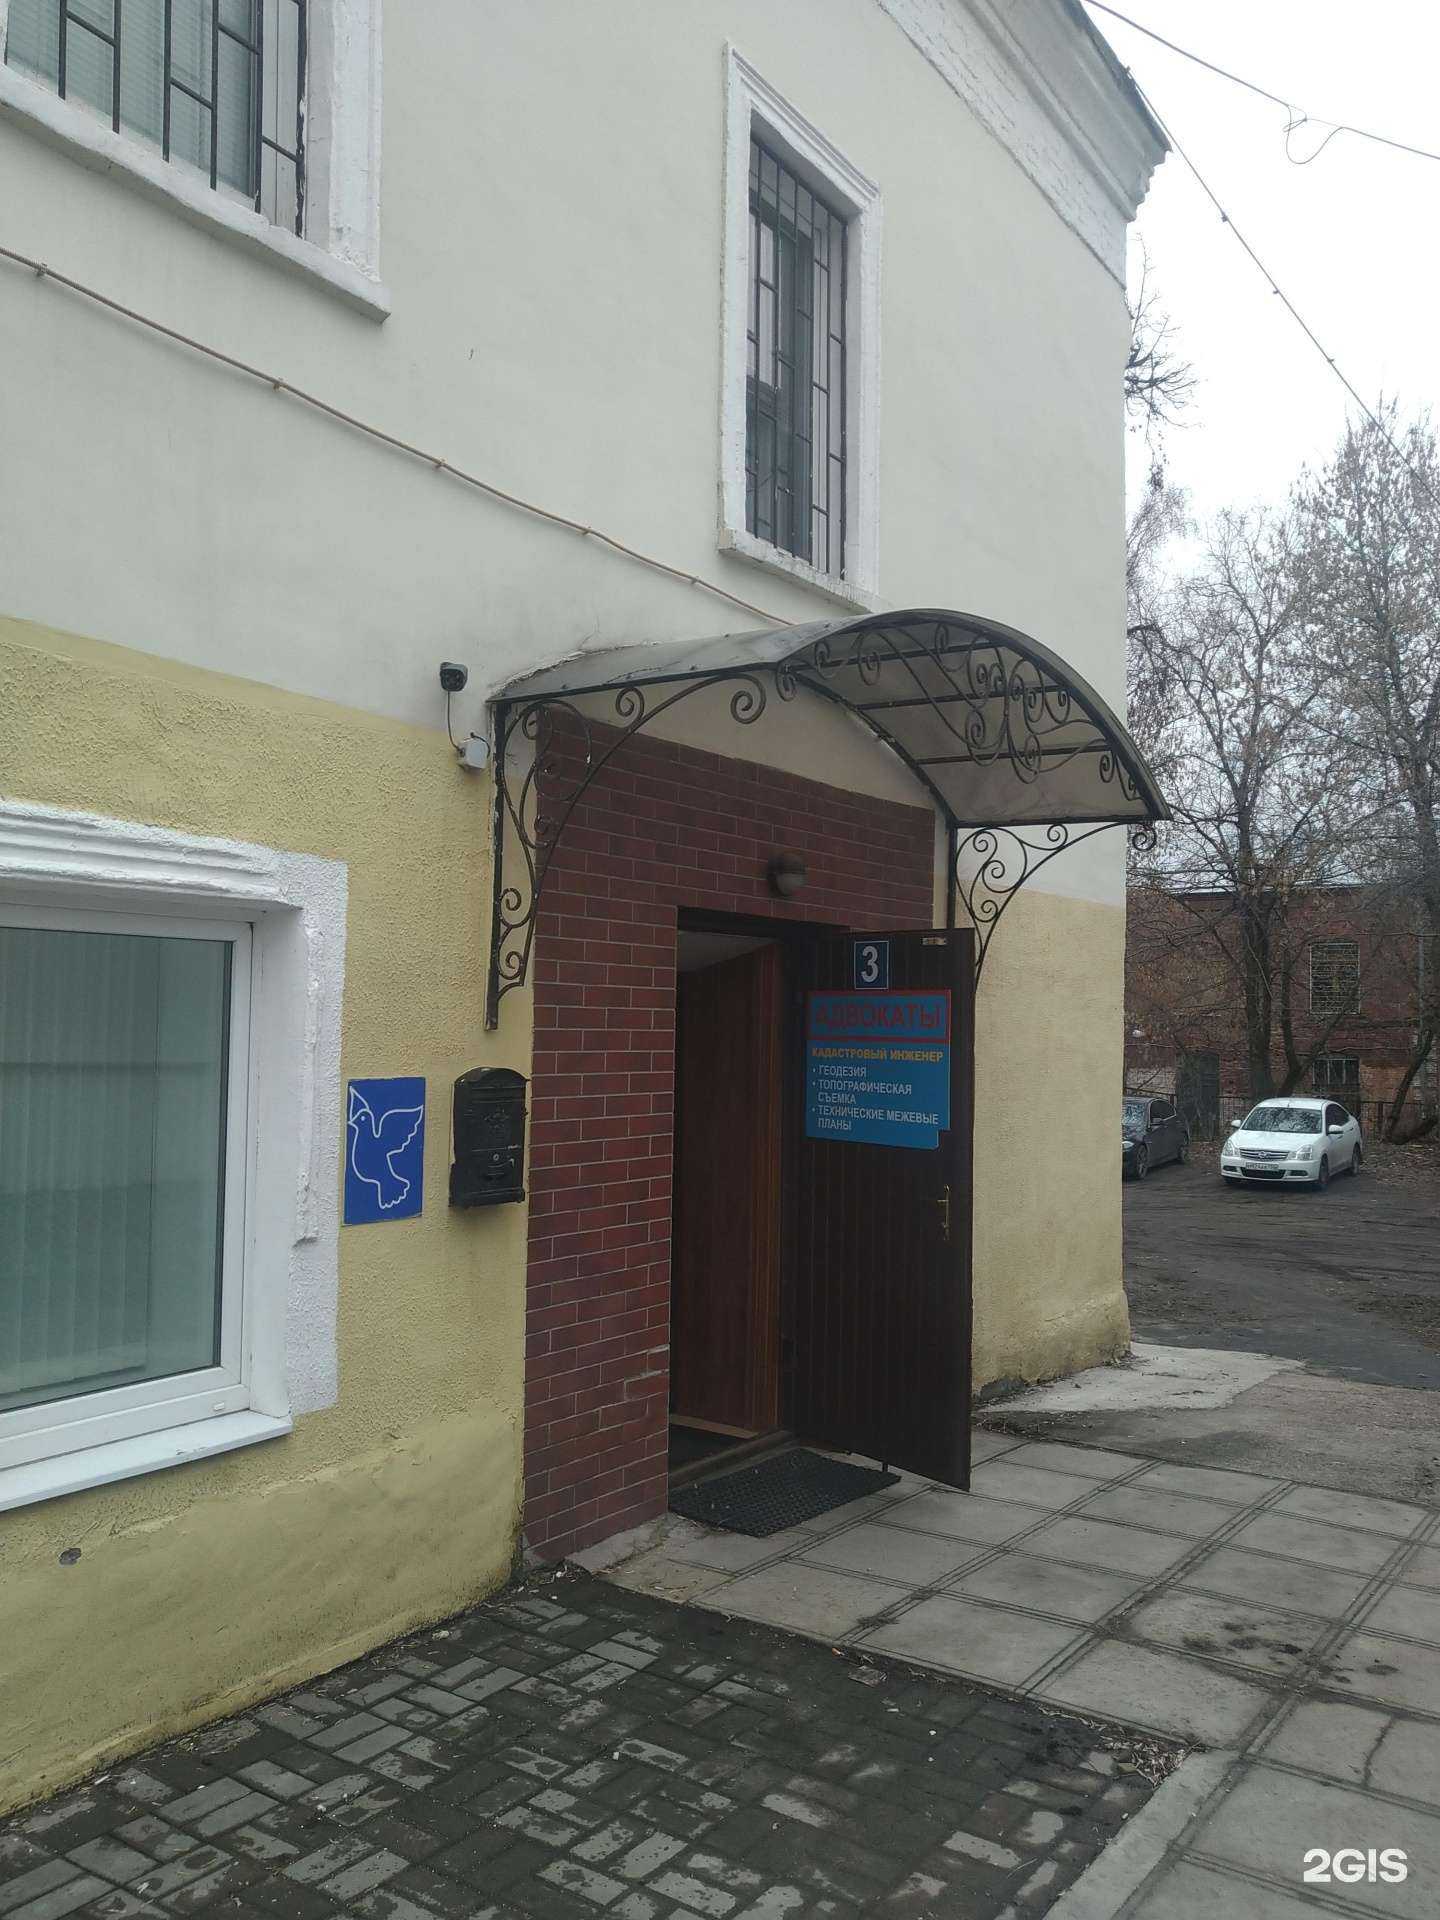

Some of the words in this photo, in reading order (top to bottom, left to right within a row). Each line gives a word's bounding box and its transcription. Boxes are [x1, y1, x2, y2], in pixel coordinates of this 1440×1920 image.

[861, 945, 879, 983] 3
[815, 1002, 941, 1028] АДВОКАТЫ
[812, 1047, 887, 1061] КАДАСТРОВЫЙ
[890, 1049, 944, 1062] ИНЖЕНЕР
[818, 1065, 867, 1078] ГЕОДЕЗИЯ
[818, 1080, 912, 1095] ТОПОГРАФИЧЕСКАЯ
[818, 1092, 856, 1105] СЪЕМКА
[818, 1105, 884, 1120] ТЕХНИЧЕСКИЕ
[887, 1110, 939, 1125] МЕЖЕВЫЕ
[818, 1118, 852, 1131] ПЛАНЫ
